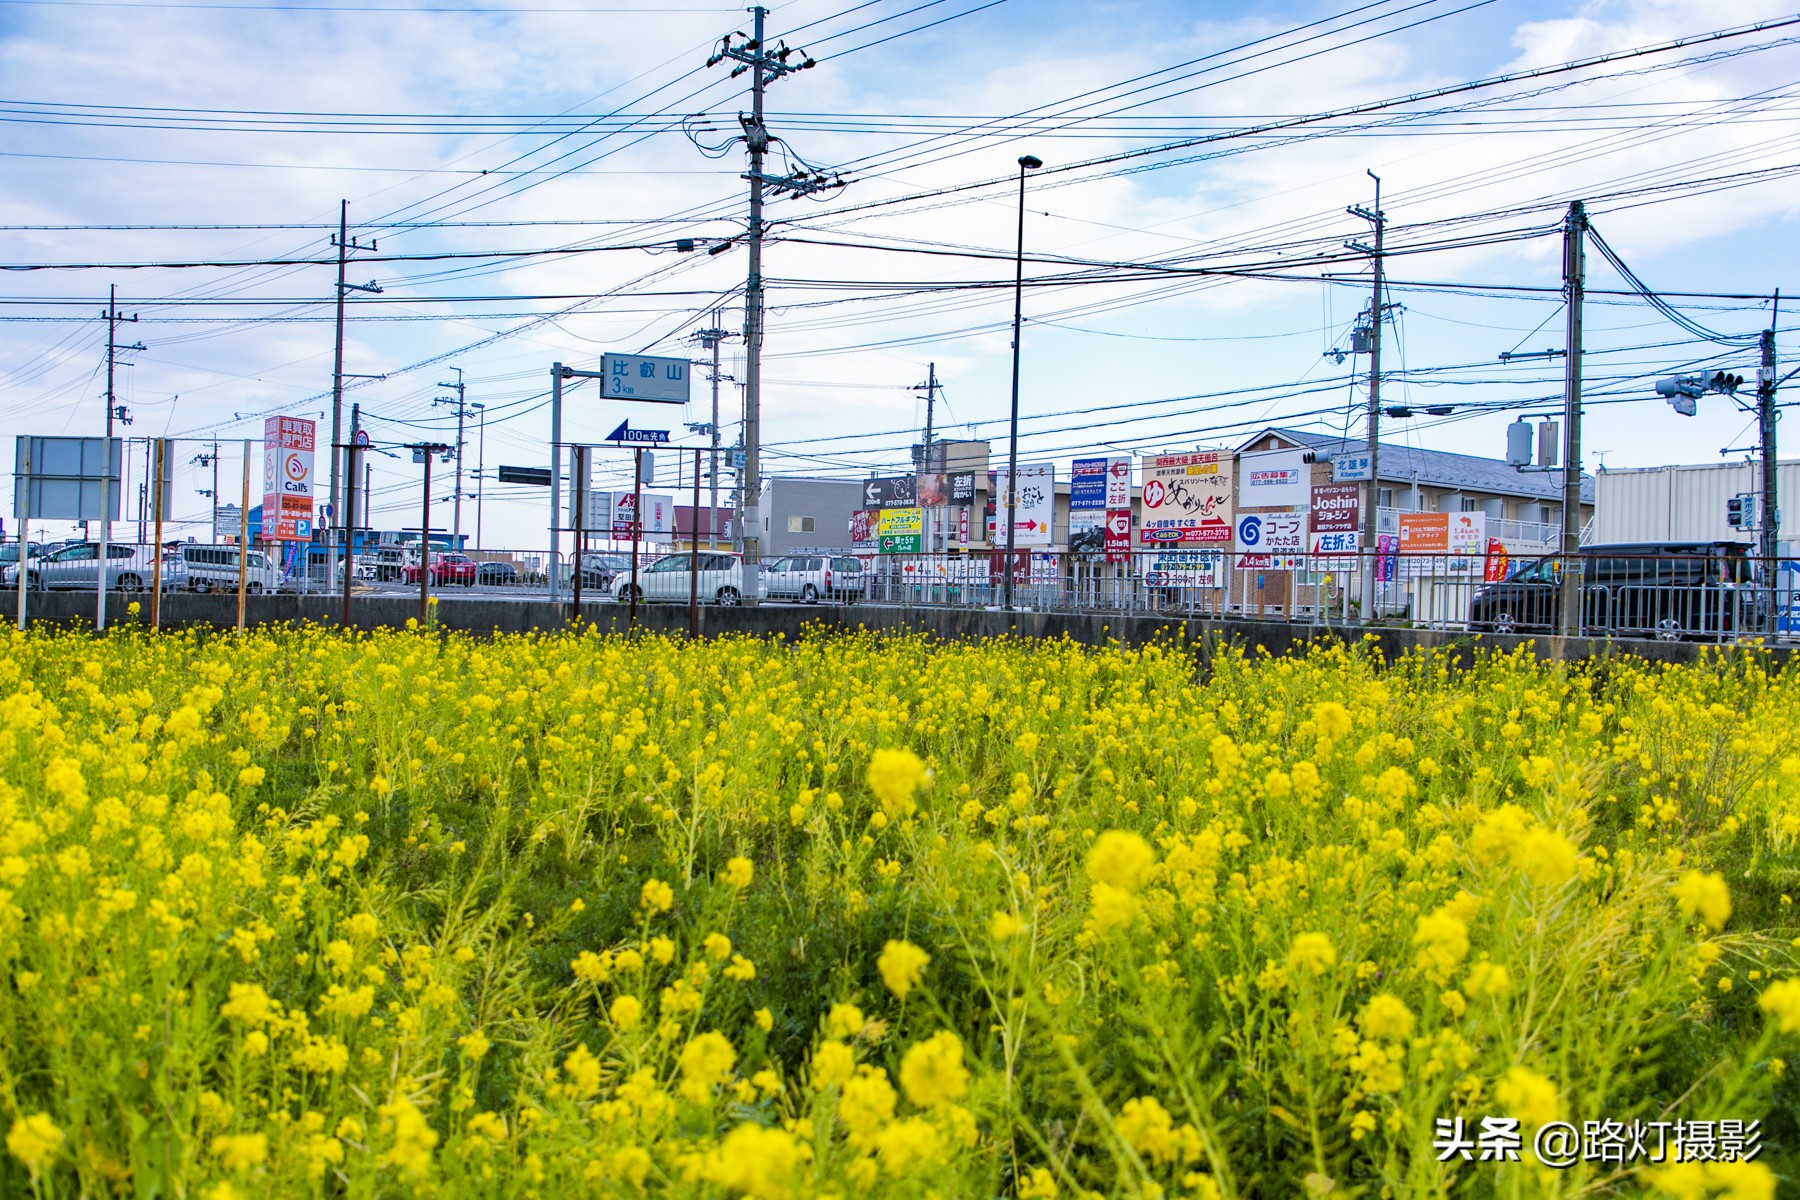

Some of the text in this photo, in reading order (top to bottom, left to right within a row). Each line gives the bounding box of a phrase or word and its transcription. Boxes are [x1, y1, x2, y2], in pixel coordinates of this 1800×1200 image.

[613, 359, 682, 380] 比叡山
[612, 377, 634, 395] 3km
[282, 419, 312, 436] 車買取
[283, 433, 312, 450] 専門店
[1156, 453, 1218, 466] 関西最大級 露天風呂
[1337, 459, 1369, 471] 北雄琴
[1186, 464, 1218, 476] 美肌の湯
[1252, 471, 1288, 480] 広告募集
[1340, 471, 1365, 479] Kitaogoto
[954, 475, 973, 487] 左折
[1110, 482, 1126, 492] ここ
[1109, 494, 1126, 504] 左折
[1146, 482, 1164, 507] ゆ
[1312, 495, 1357, 510] Joshin
[618, 513, 635, 521] 堅田
[1318, 510, 1350, 521] ジョーシン
[1744, 498, 1752, 526] 押ボタン式
[881, 515, 920, 524] ハートフルギフト
[1266, 521, 1300, 534] コープ
[1266, 535, 1300, 546] かたた店
[1321, 534, 1345, 551] 左折
[1348, 533, 1355, 544] 3
